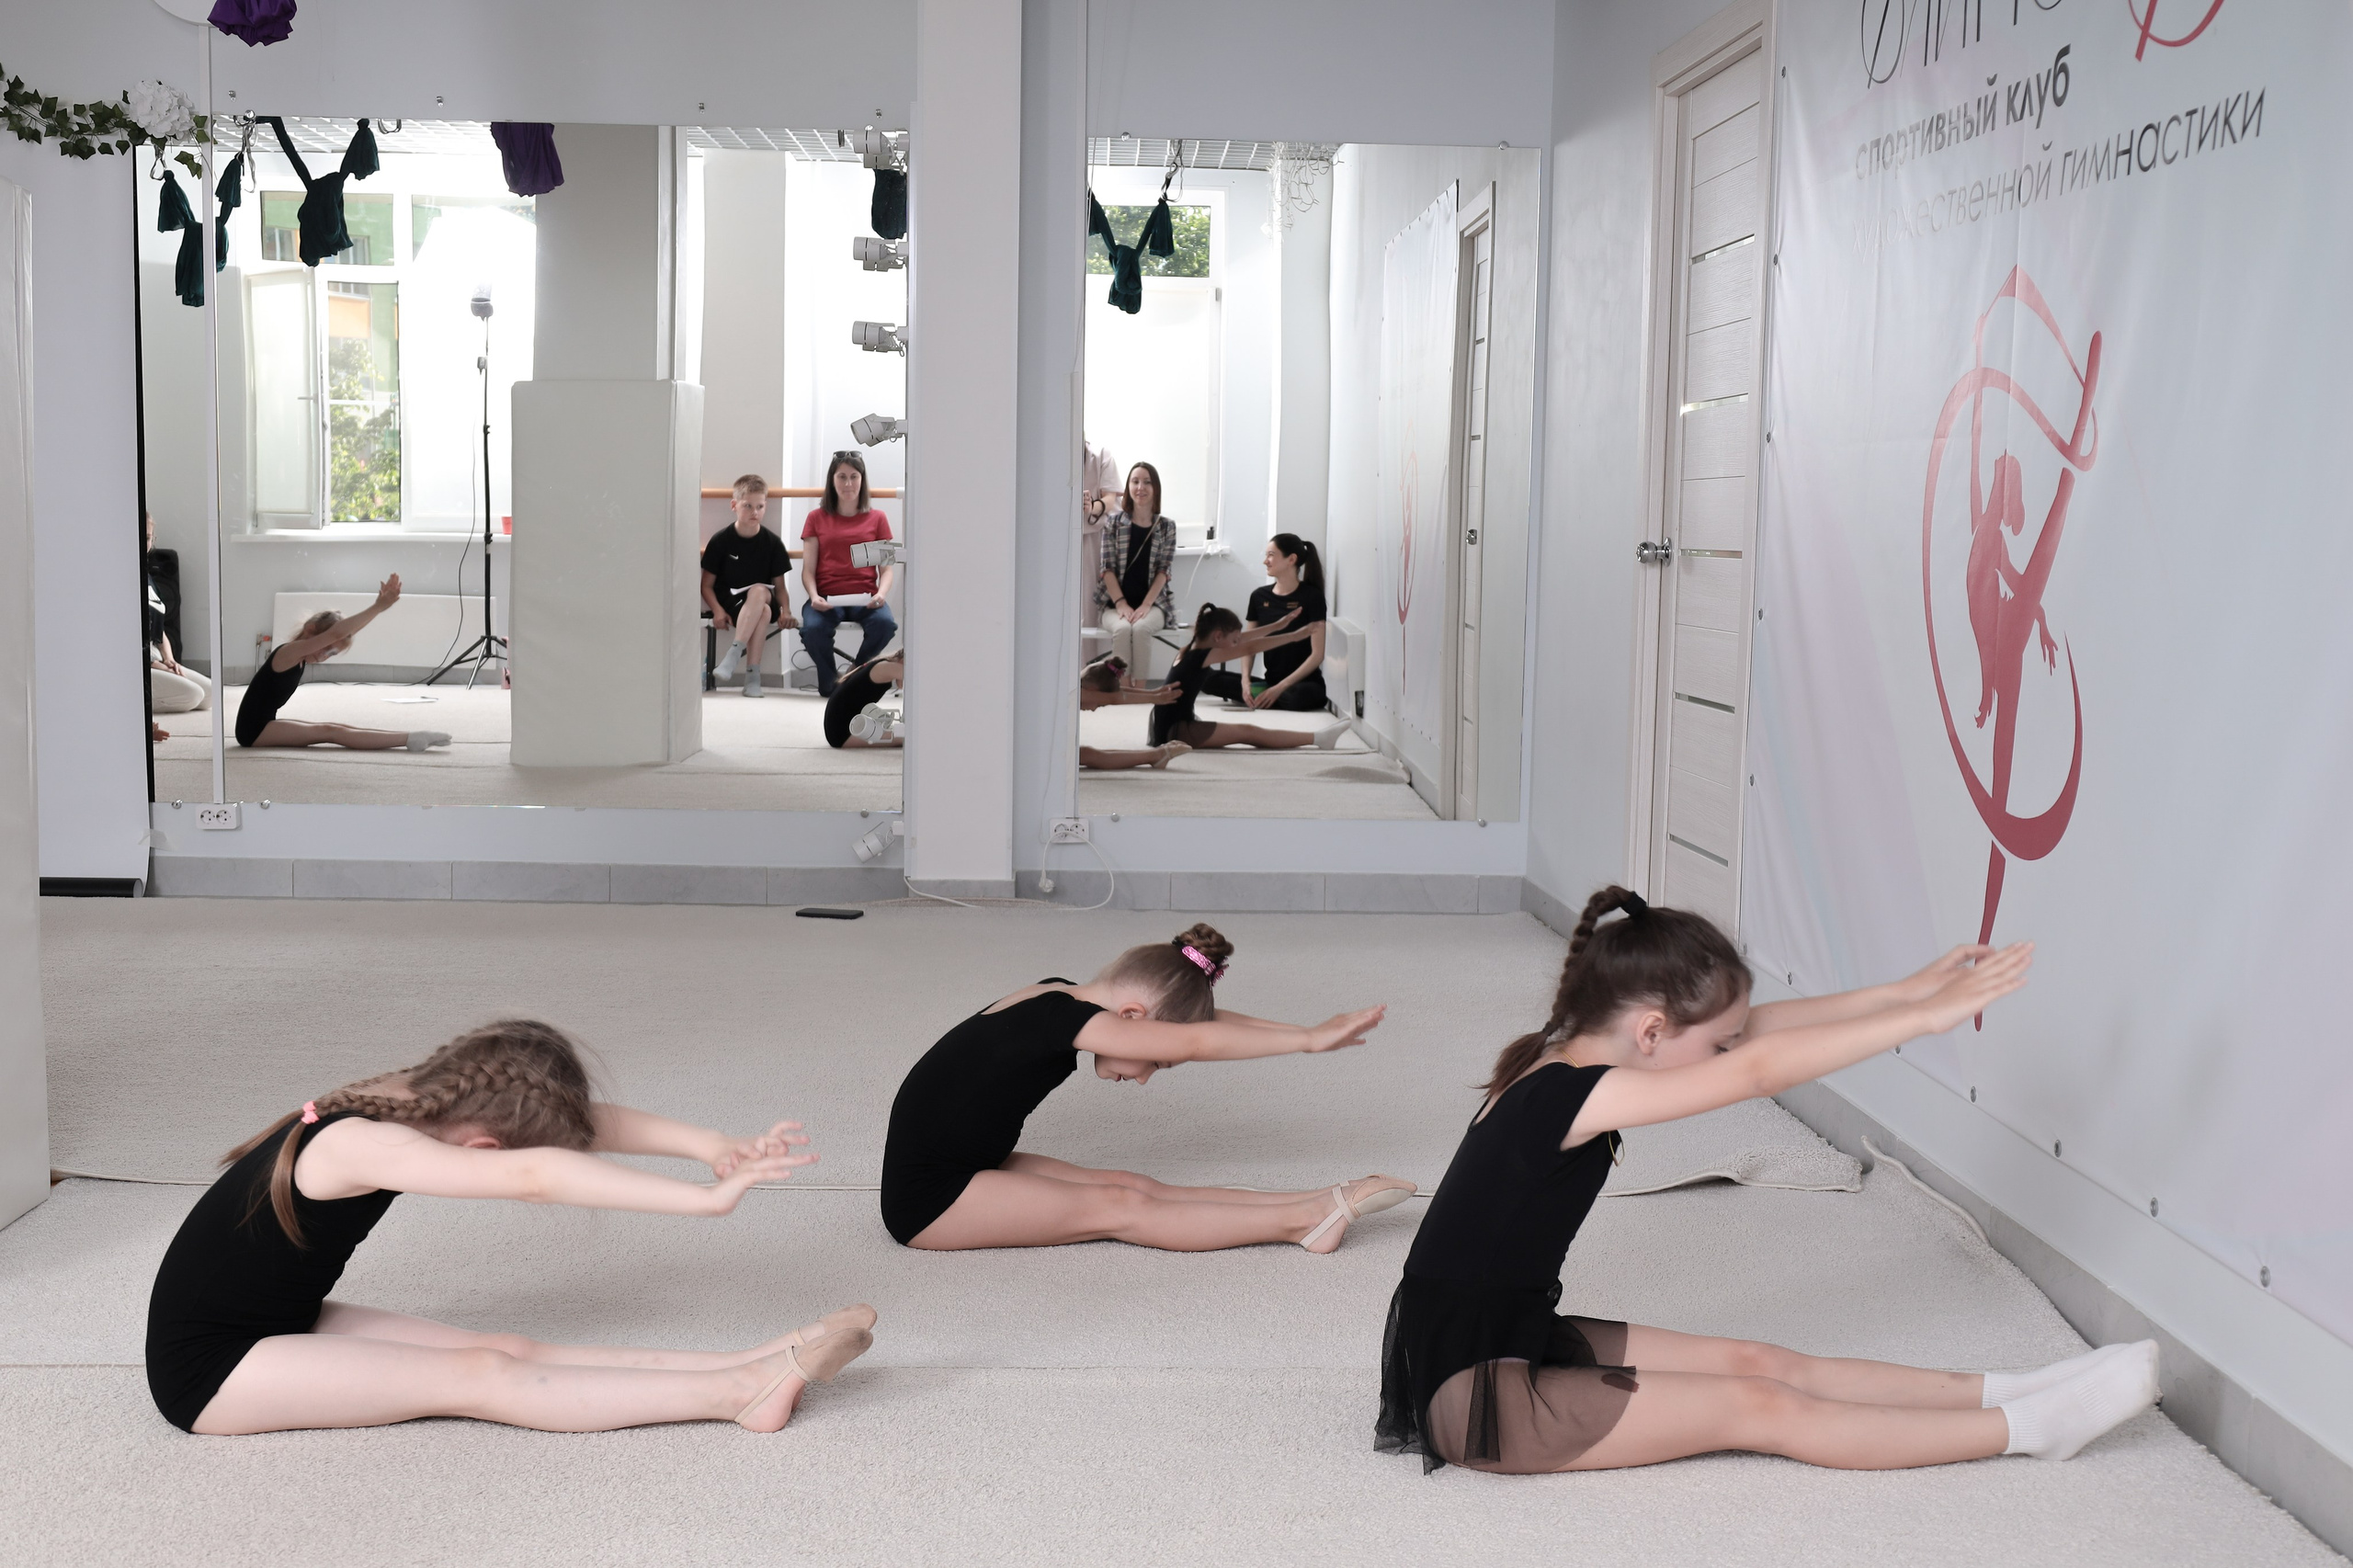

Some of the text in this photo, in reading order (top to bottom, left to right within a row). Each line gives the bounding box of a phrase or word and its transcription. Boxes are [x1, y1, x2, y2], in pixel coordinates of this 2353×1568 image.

[1856, 74, 1998, 179] спортивный
[2006, 43, 2072, 130] клуб
[2059, 86, 2266, 197] гимнастики
